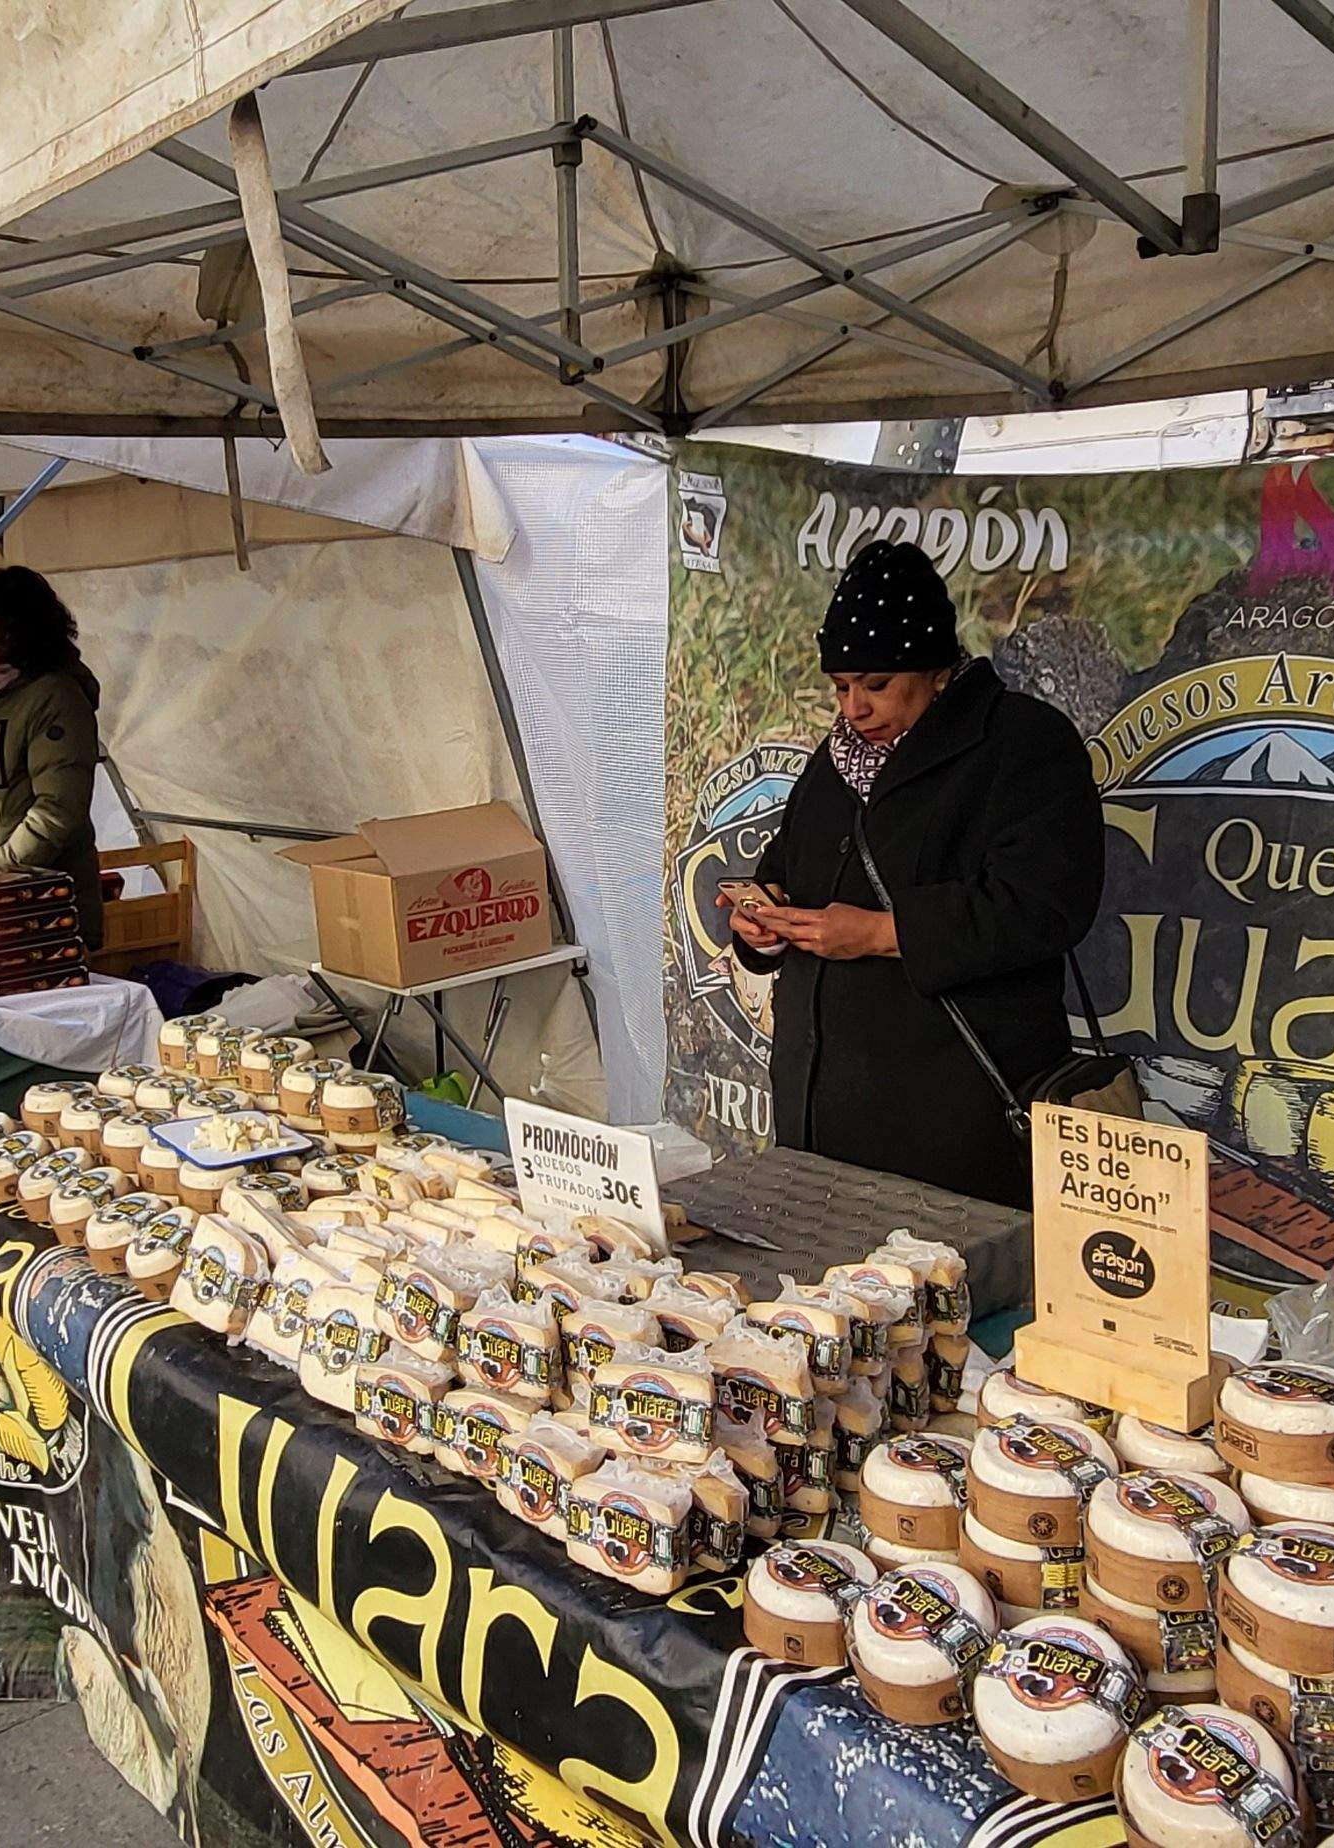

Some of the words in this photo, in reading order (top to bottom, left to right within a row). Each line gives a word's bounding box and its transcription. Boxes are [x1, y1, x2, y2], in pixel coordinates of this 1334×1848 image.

[797, 486, 1069, 577] Aragón
[1086, 673, 1239, 790] Quesos
[521, 1156, 535, 1179] 3
[533, 1154, 583, 1177] QUESOS
[522, 1122, 619, 1171] PROMOCIÓN
[1060, 1149, 1089, 1172] es
[1097, 1152, 1131, 1181] de
[1097, 1121, 1192, 1171] bueno,
[536, 1172, 603, 1201] TRUFADOS
[601, 1176, 643, 1209] 30€
[620, 1388, 677, 1422] Guara
[600, 1507, 649, 1545] Guara
[892, 1576, 946, 1624] Guara
[1023, 1641, 1092, 1682] Guara
[233, 1661, 288, 1758] Las
[1178, 1724, 1239, 1787] Guara
